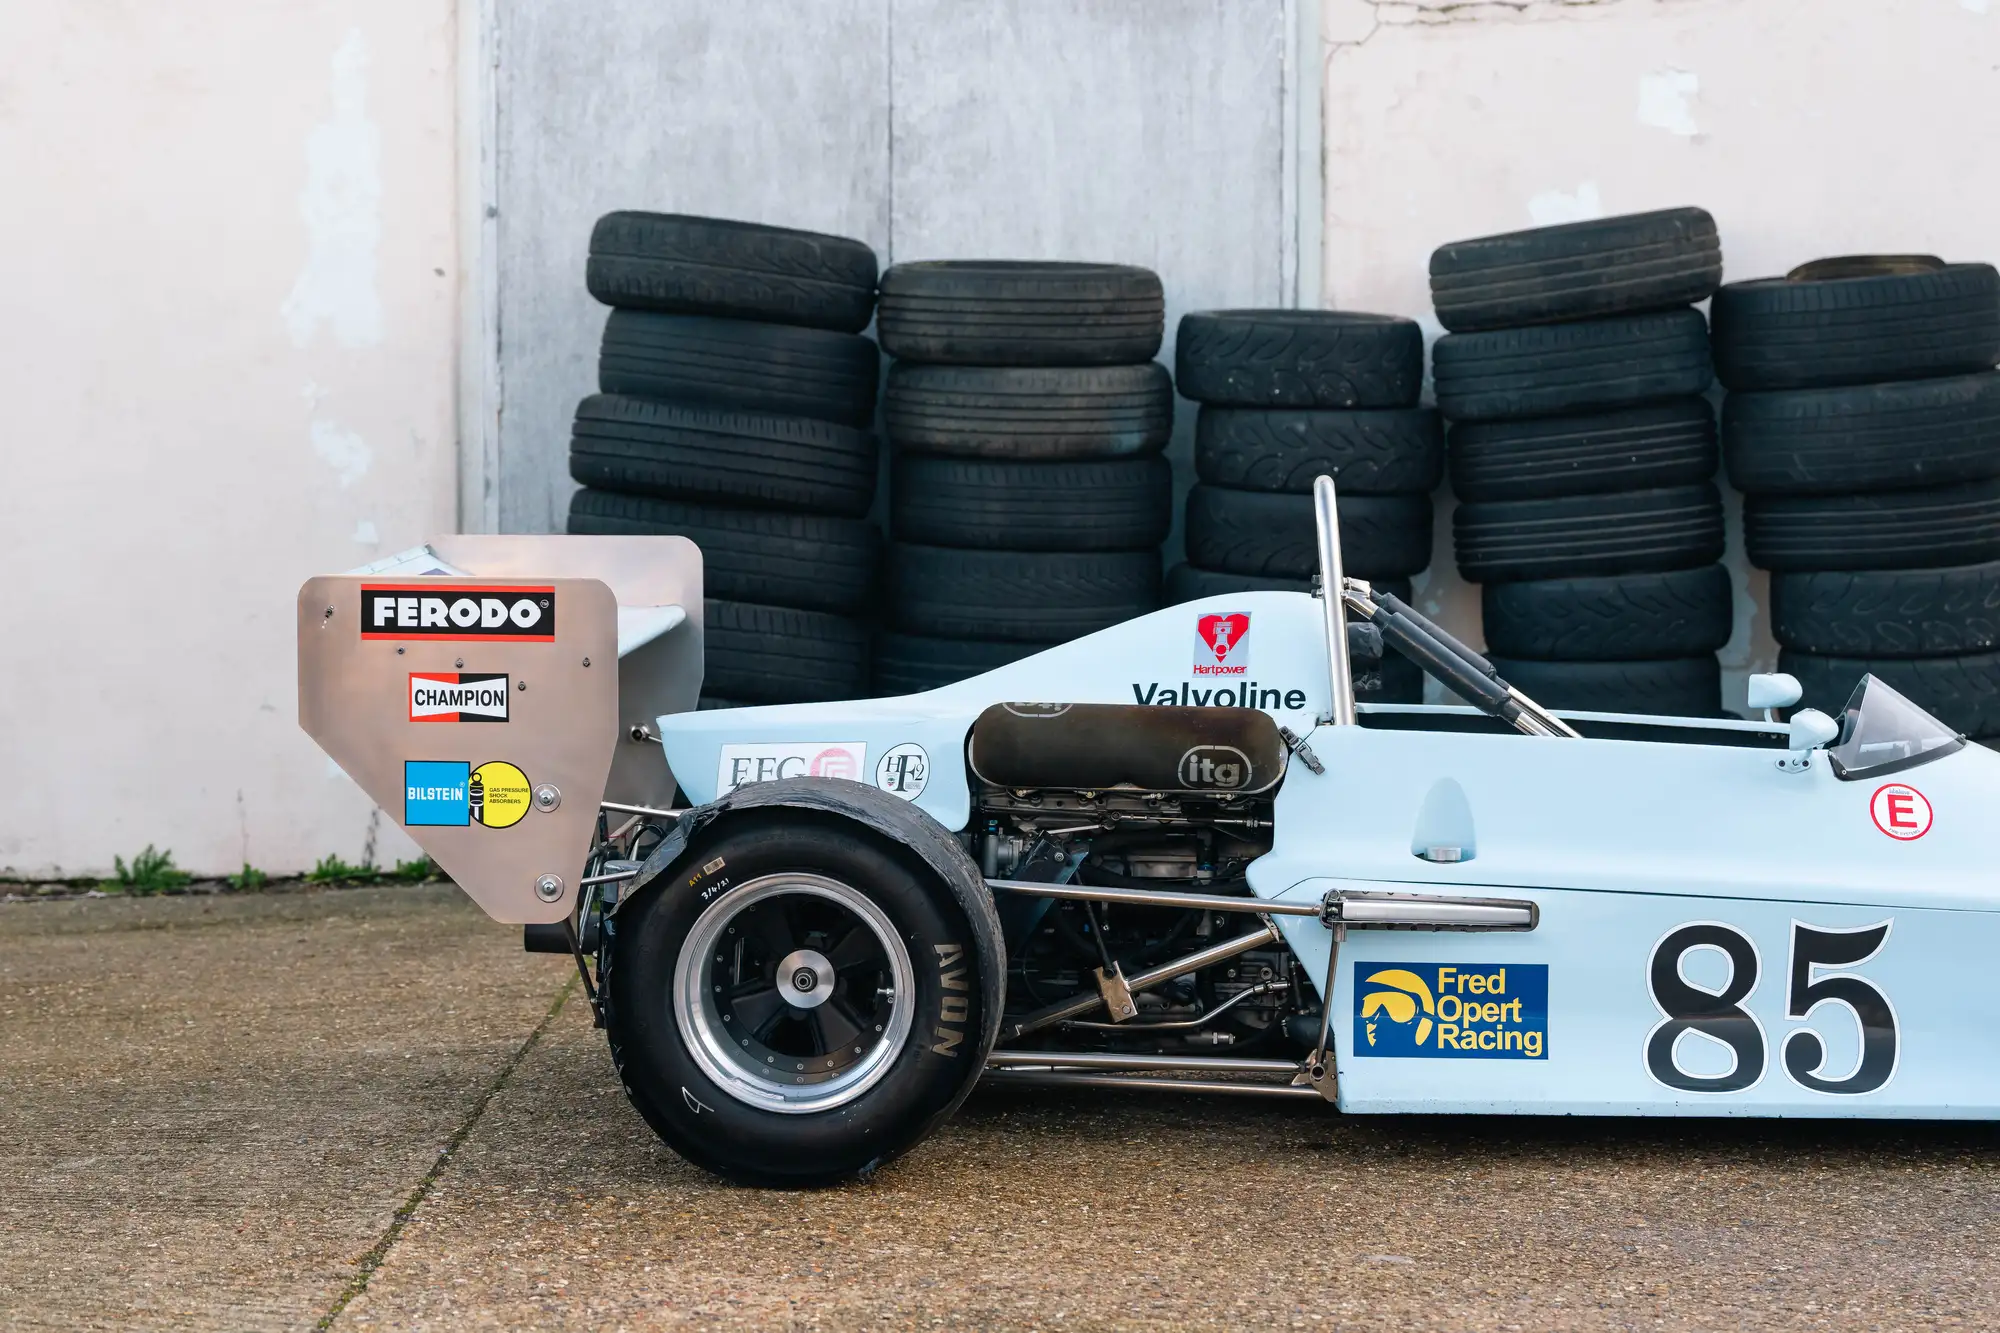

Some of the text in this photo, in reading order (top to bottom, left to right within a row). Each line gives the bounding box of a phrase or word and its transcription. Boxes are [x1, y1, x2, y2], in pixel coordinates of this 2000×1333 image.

[374, 597, 541, 628] FERODO
[1193, 665, 1247, 676] Hartpower
[415, 689, 505, 706] CHAMPION
[1132, 682, 1307, 710] Valvoline
[1189, 754, 1240, 787] itg
[1887, 794, 1917, 828] E
[1438, 967, 1506, 994] Fred
[931, 944, 969, 1058] AVON
[1437, 995, 1523, 1028] Opert
[1643, 917, 1900, 1095] 85
[1437, 1024, 1543, 1057] Racing
